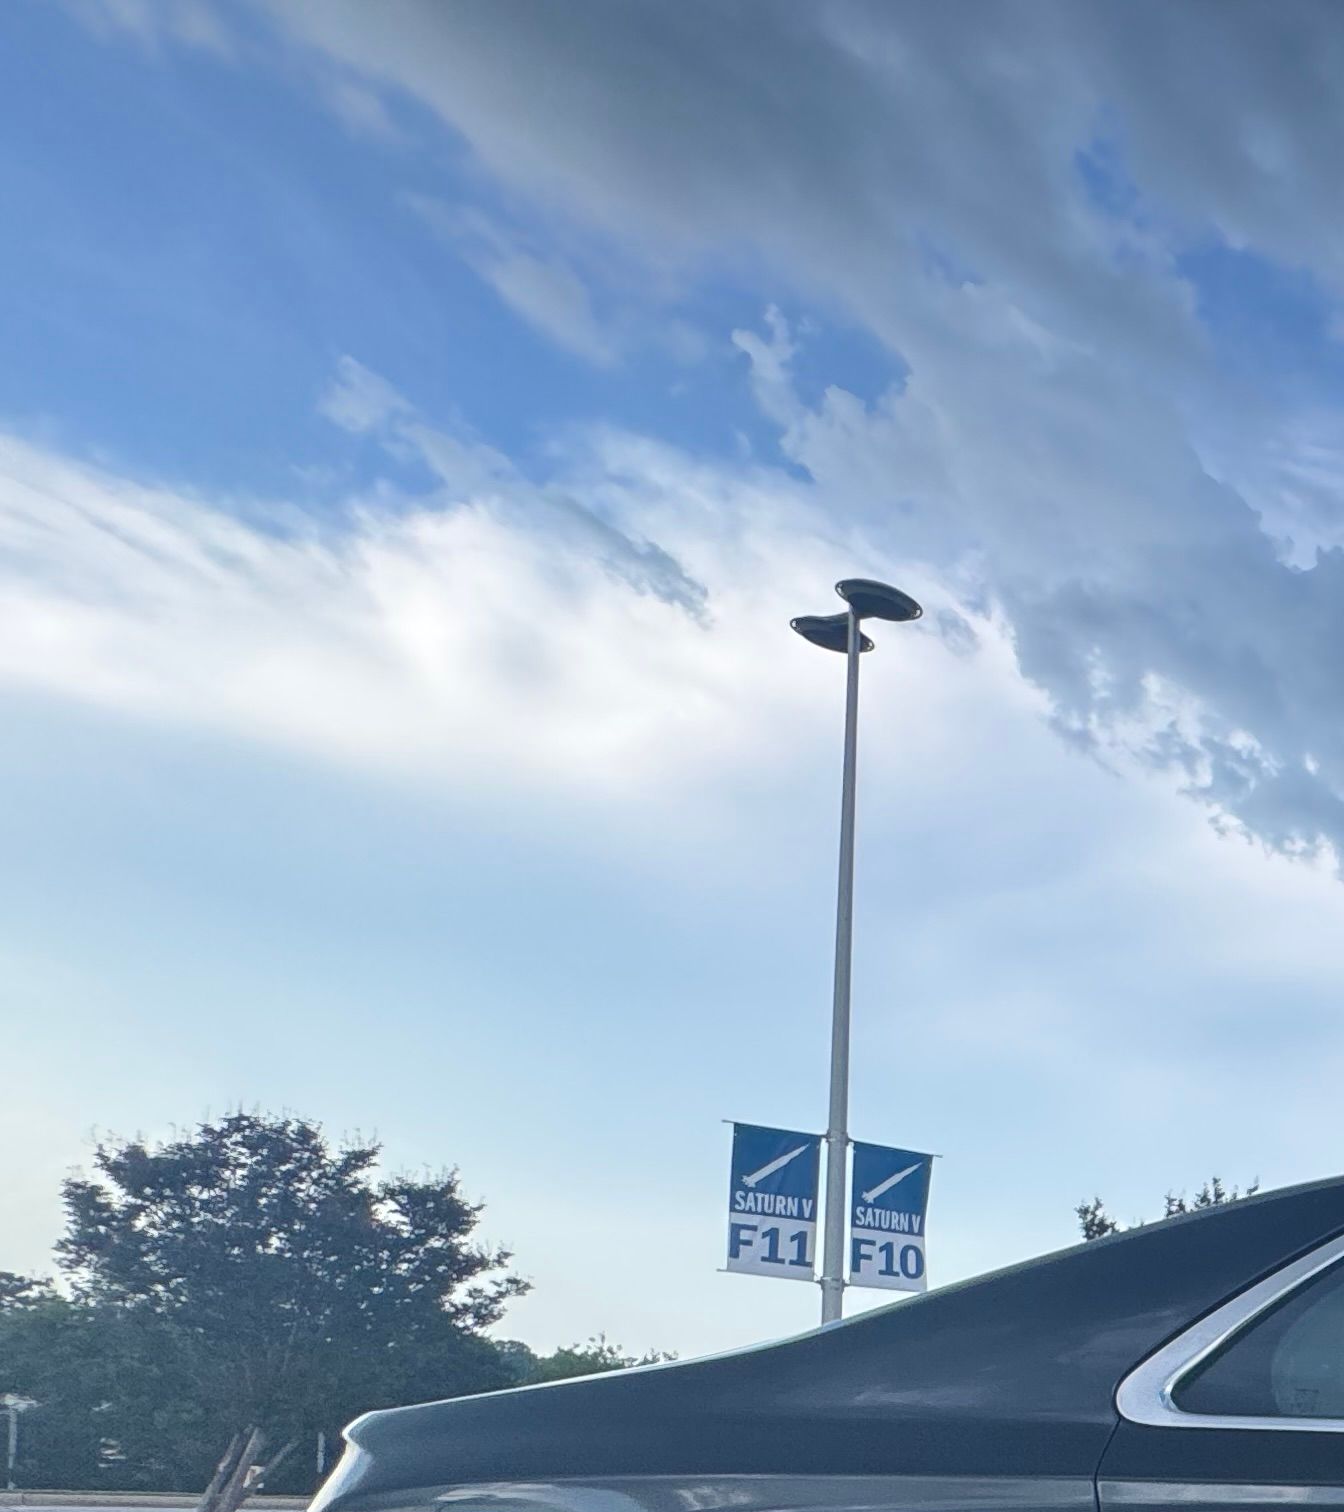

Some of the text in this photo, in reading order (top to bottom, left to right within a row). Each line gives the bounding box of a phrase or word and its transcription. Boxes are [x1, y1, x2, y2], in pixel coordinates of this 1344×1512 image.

[735, 1190, 813, 1219] SATURN V
[855, 1206, 921, 1234] SATURN V
[729, 1223, 813, 1267] F11
[852, 1237, 925, 1280] F10
